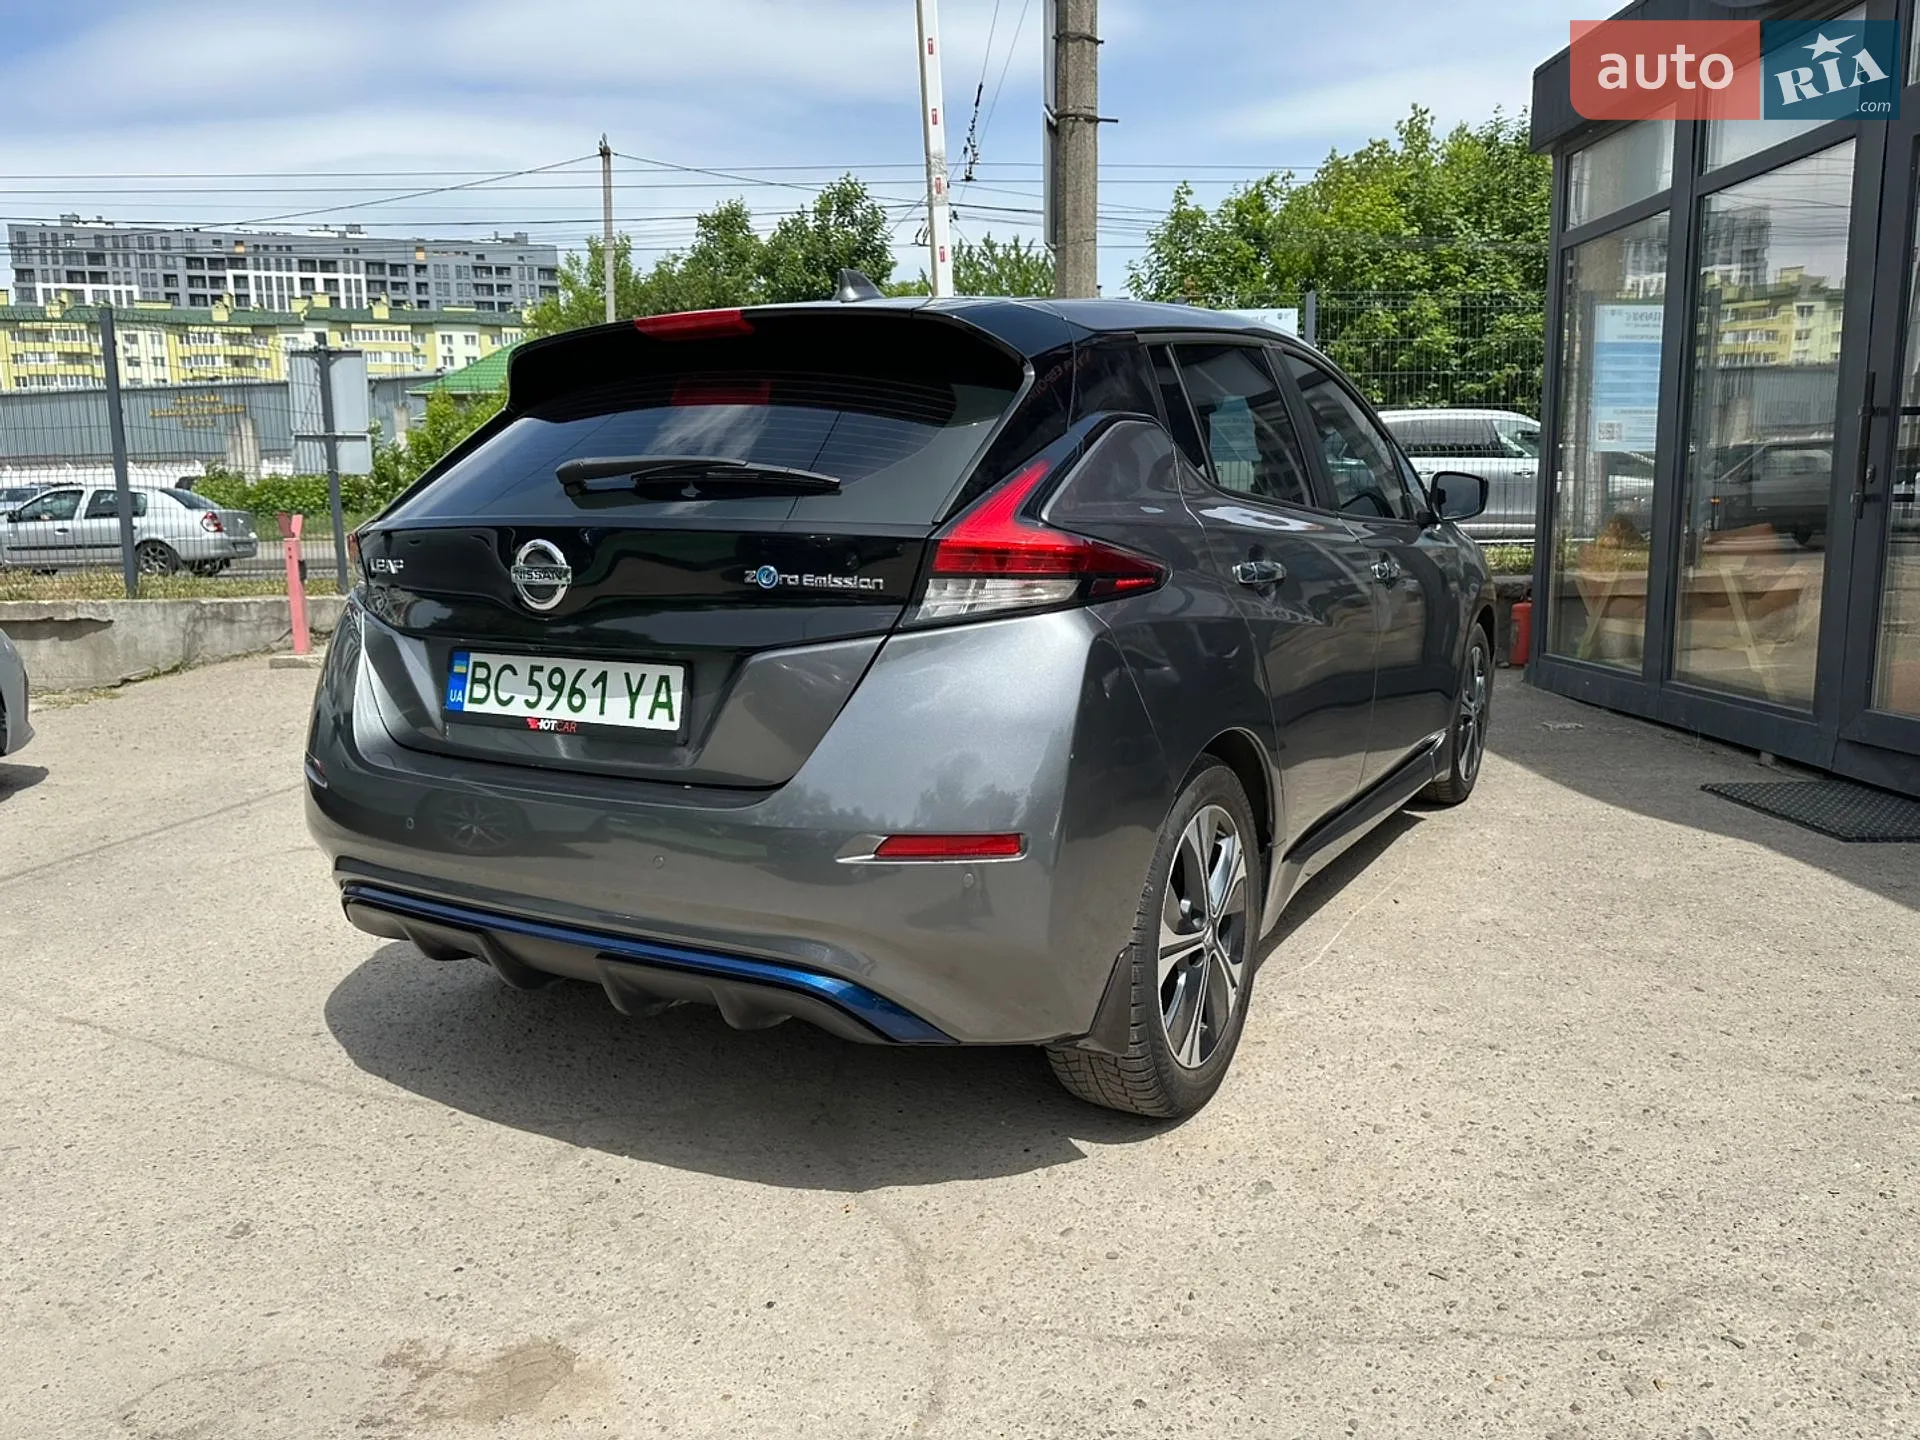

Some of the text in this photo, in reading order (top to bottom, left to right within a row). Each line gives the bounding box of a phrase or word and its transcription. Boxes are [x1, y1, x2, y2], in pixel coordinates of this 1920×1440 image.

[513, 567, 567, 581] NISSAN
[802, 574, 884, 590] Emission
[450, 689, 463, 702] UA
[524, 664, 608, 716] 5961
